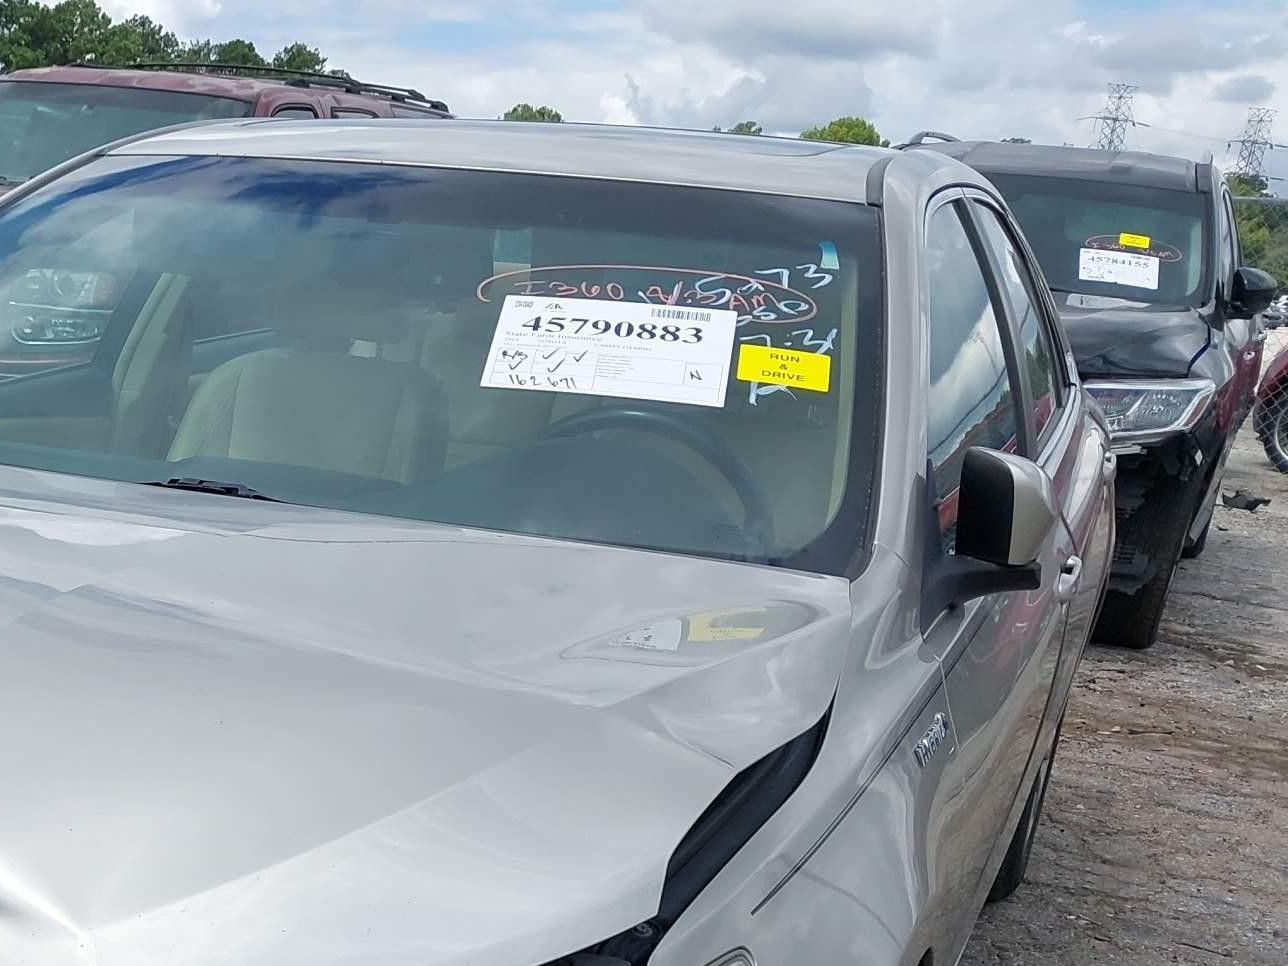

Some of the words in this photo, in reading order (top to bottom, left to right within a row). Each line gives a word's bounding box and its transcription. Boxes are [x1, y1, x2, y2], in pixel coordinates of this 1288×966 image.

[521, 315, 703, 344] 45790883
[769, 352, 801, 364] RUN
[779, 363, 788, 371] &
[761, 369, 806, 383] DRIVE
